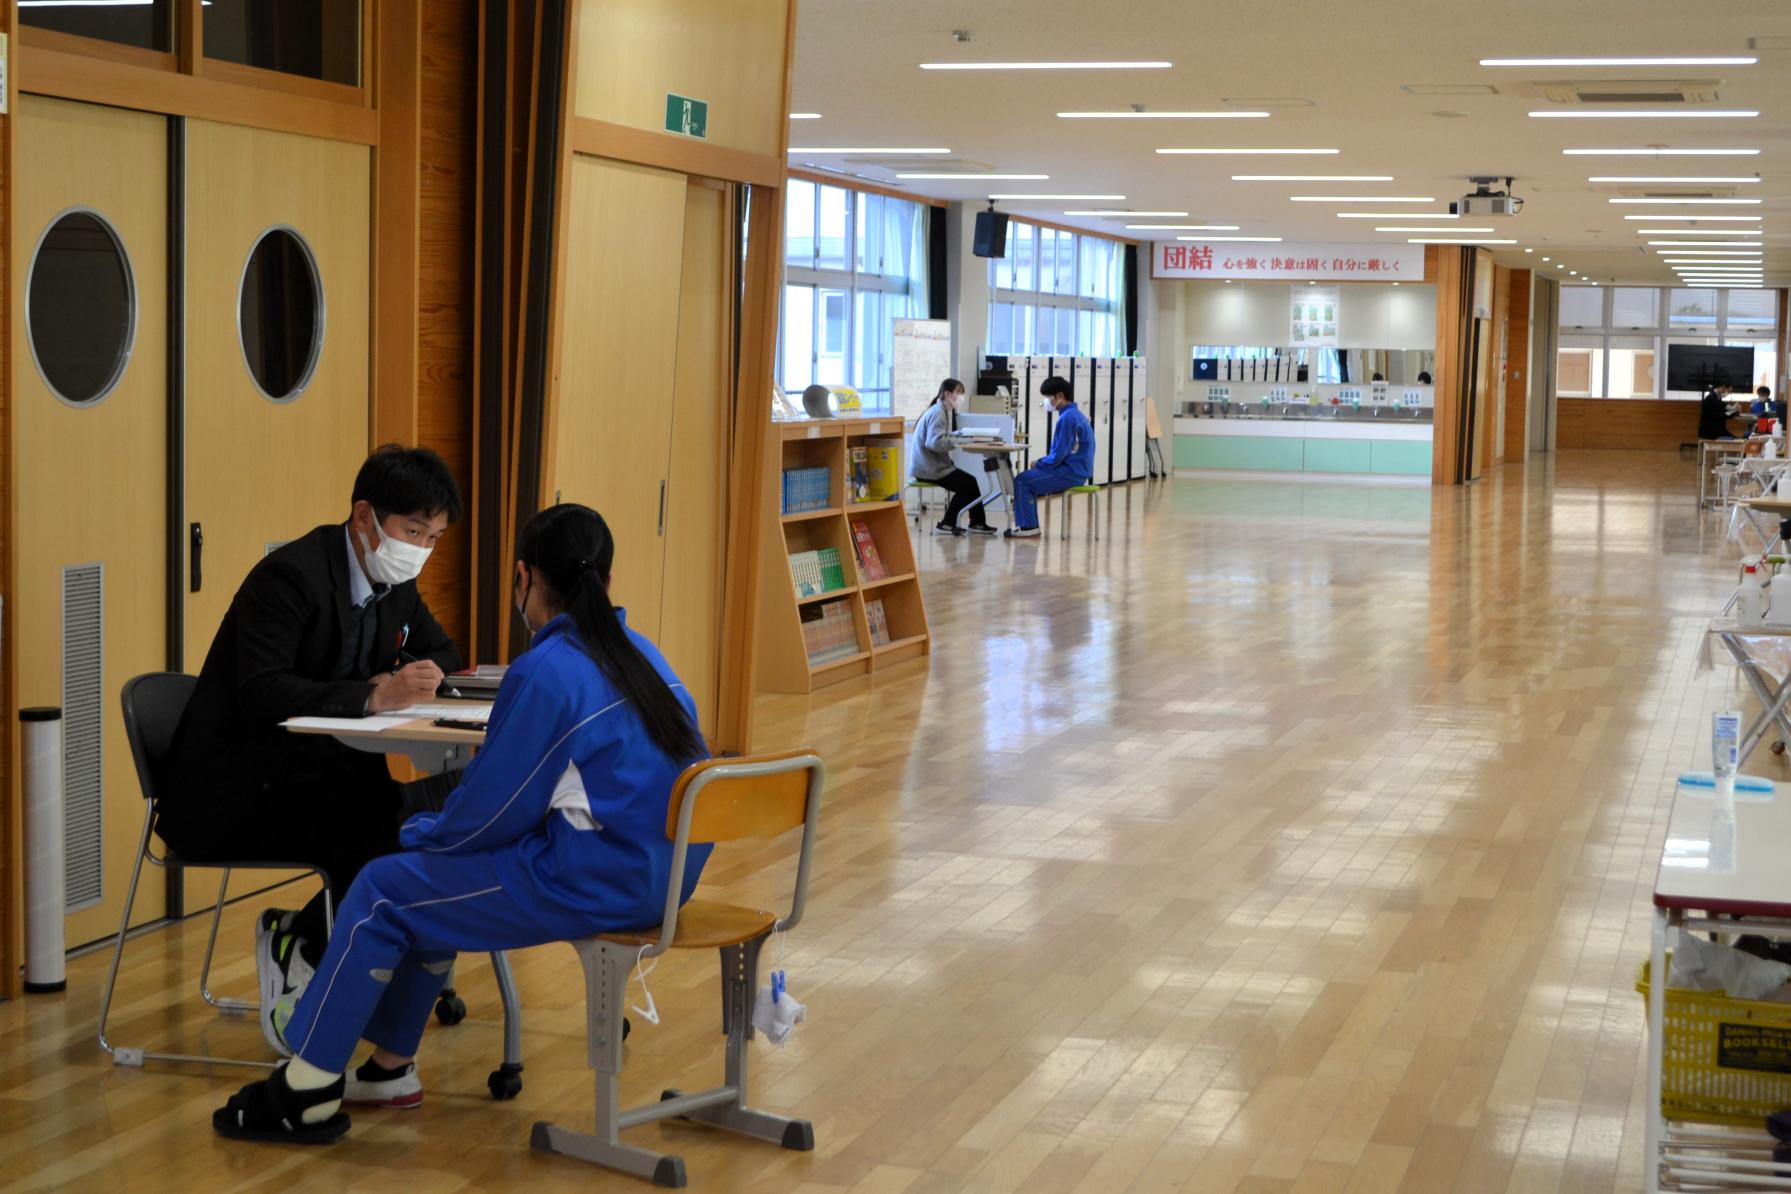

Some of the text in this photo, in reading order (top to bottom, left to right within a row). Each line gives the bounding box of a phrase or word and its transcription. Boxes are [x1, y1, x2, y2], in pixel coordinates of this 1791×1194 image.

[1163, 245, 1213, 270] 団結
[1223, 257, 1400, 271] 心を強く 決意は固く 自分に厳しく
